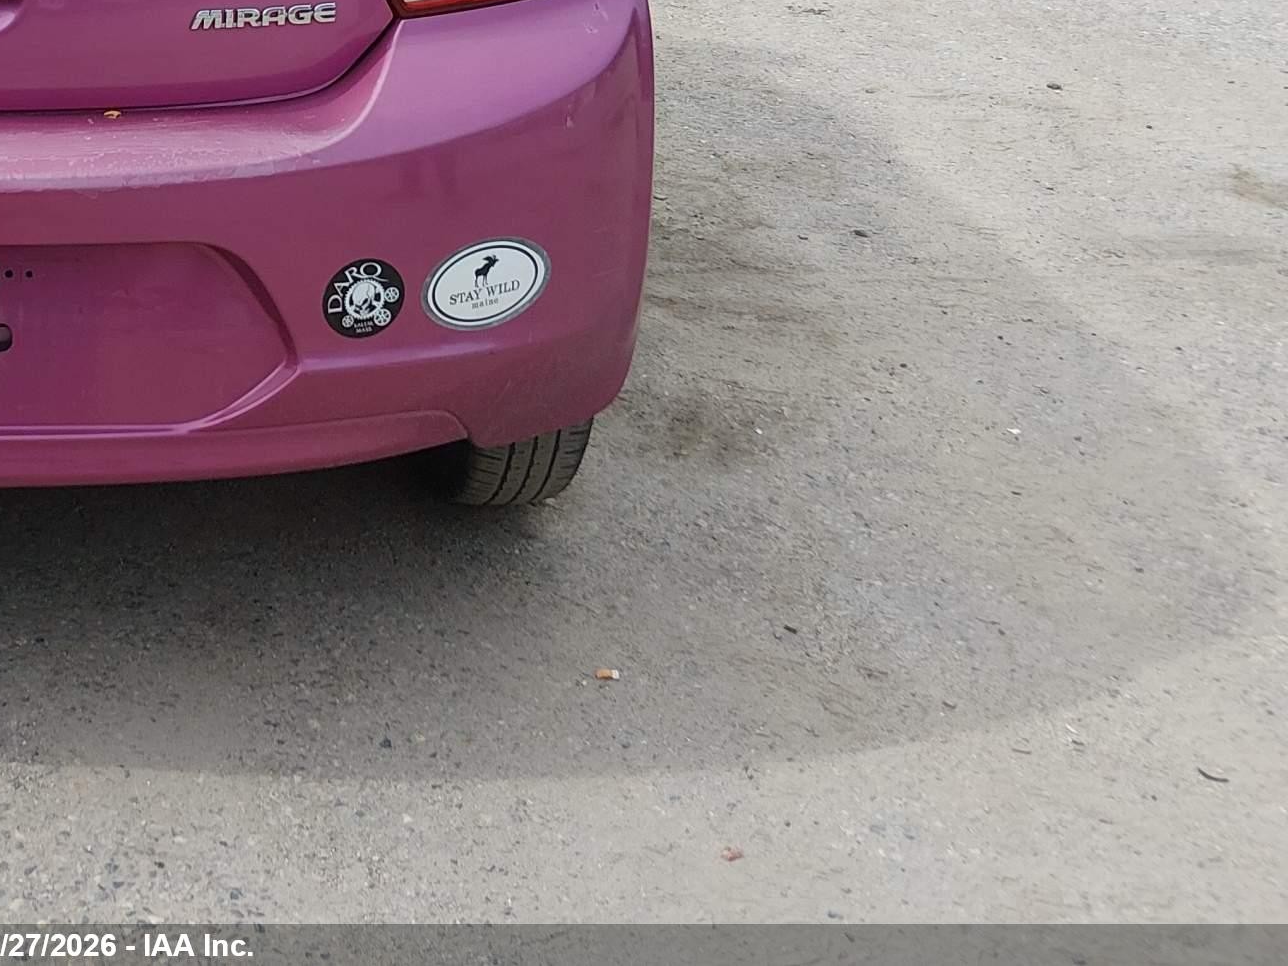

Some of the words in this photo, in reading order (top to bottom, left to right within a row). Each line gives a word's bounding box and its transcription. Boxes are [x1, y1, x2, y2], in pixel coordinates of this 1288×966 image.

[191, 2, 337, 30] MIRAGE
[327, 261, 389, 314] DARO
[449, 288, 482, 307] STAY
[486, 279, 520, 297] WILD
